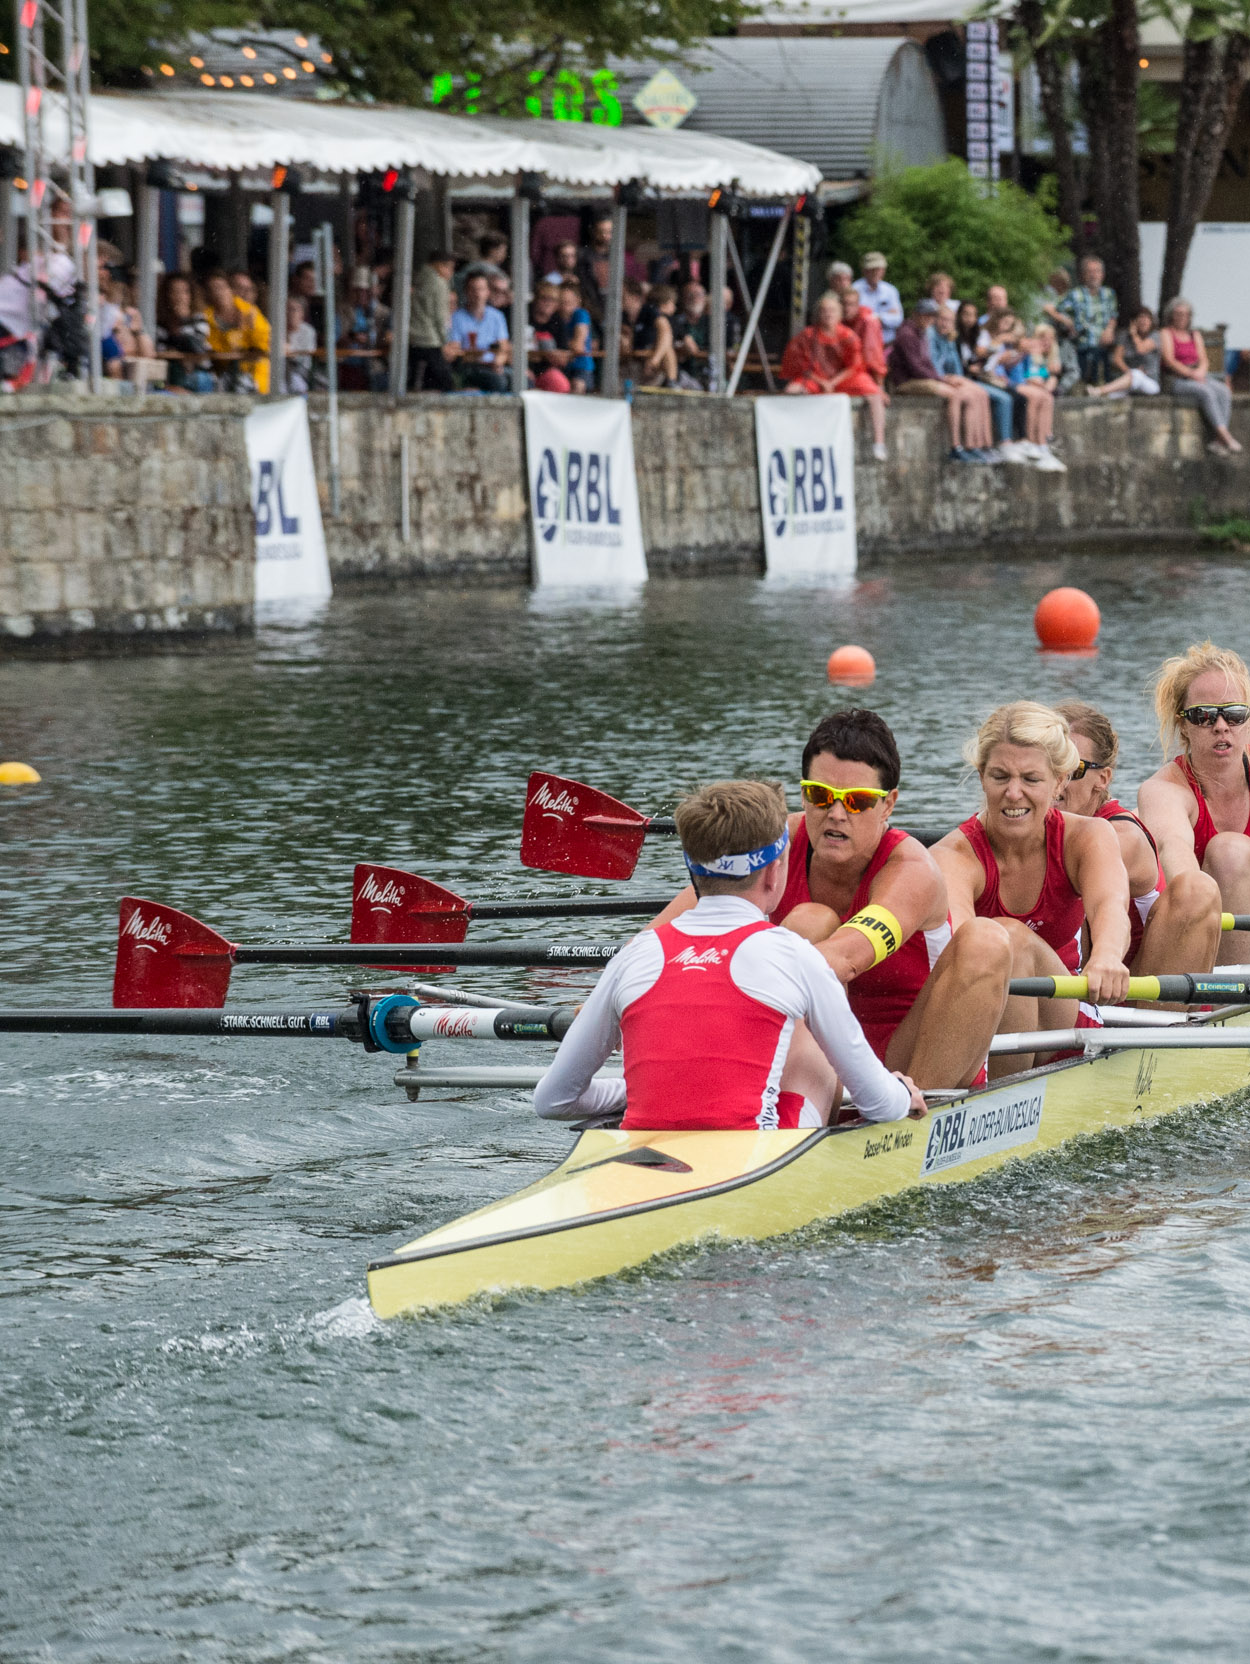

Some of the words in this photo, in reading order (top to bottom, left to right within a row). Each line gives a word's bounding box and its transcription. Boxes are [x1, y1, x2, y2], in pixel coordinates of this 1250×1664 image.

[257, 460, 298, 536] BL
[566, 451, 621, 525] RBL
[793, 446, 844, 514] RBL
[549, 945, 571, 957] STARK.
[571, 945, 601, 957] SCHNELL.
[224, 1015, 250, 1028] STARK.
[251, 1015, 287, 1028] SCHNELL.
[288, 1016, 306, 1029] GUT.
[315, 1015, 330, 1026] RBL
[939, 1110, 967, 1155] RBL
[967, 1096, 1042, 1148] RUDER-BUNDESLIGA
